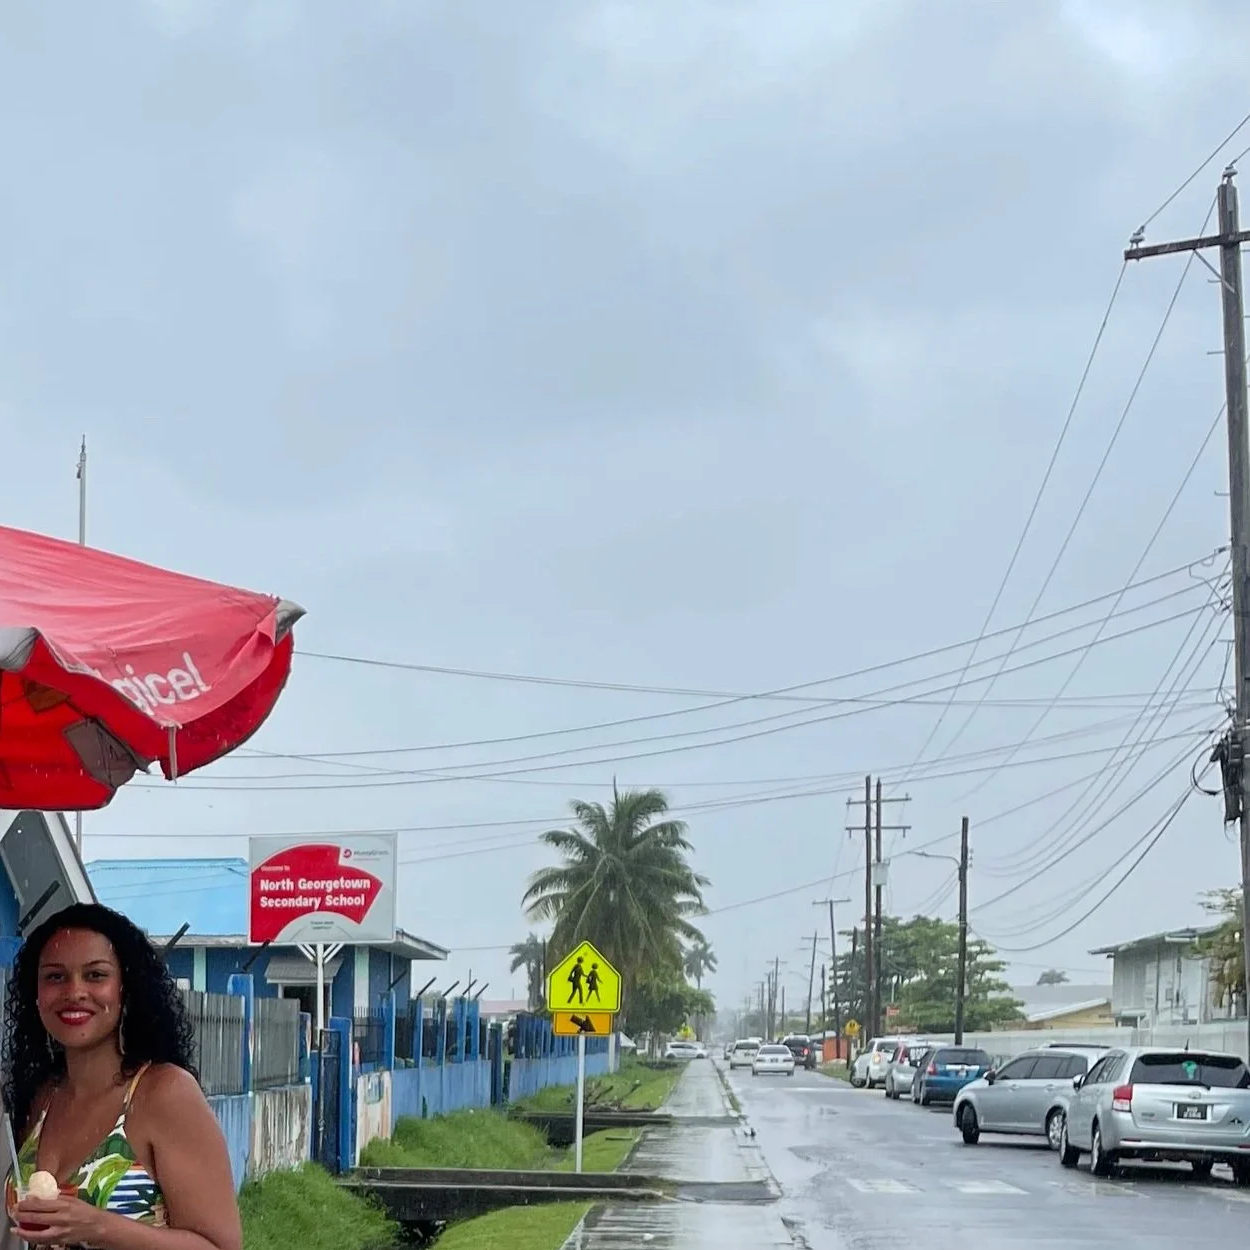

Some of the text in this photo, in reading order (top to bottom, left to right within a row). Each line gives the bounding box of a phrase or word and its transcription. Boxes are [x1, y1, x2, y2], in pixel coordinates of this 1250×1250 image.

[260, 876, 371, 892] North Georgetown
[260, 894, 365, 910] Secondary School
